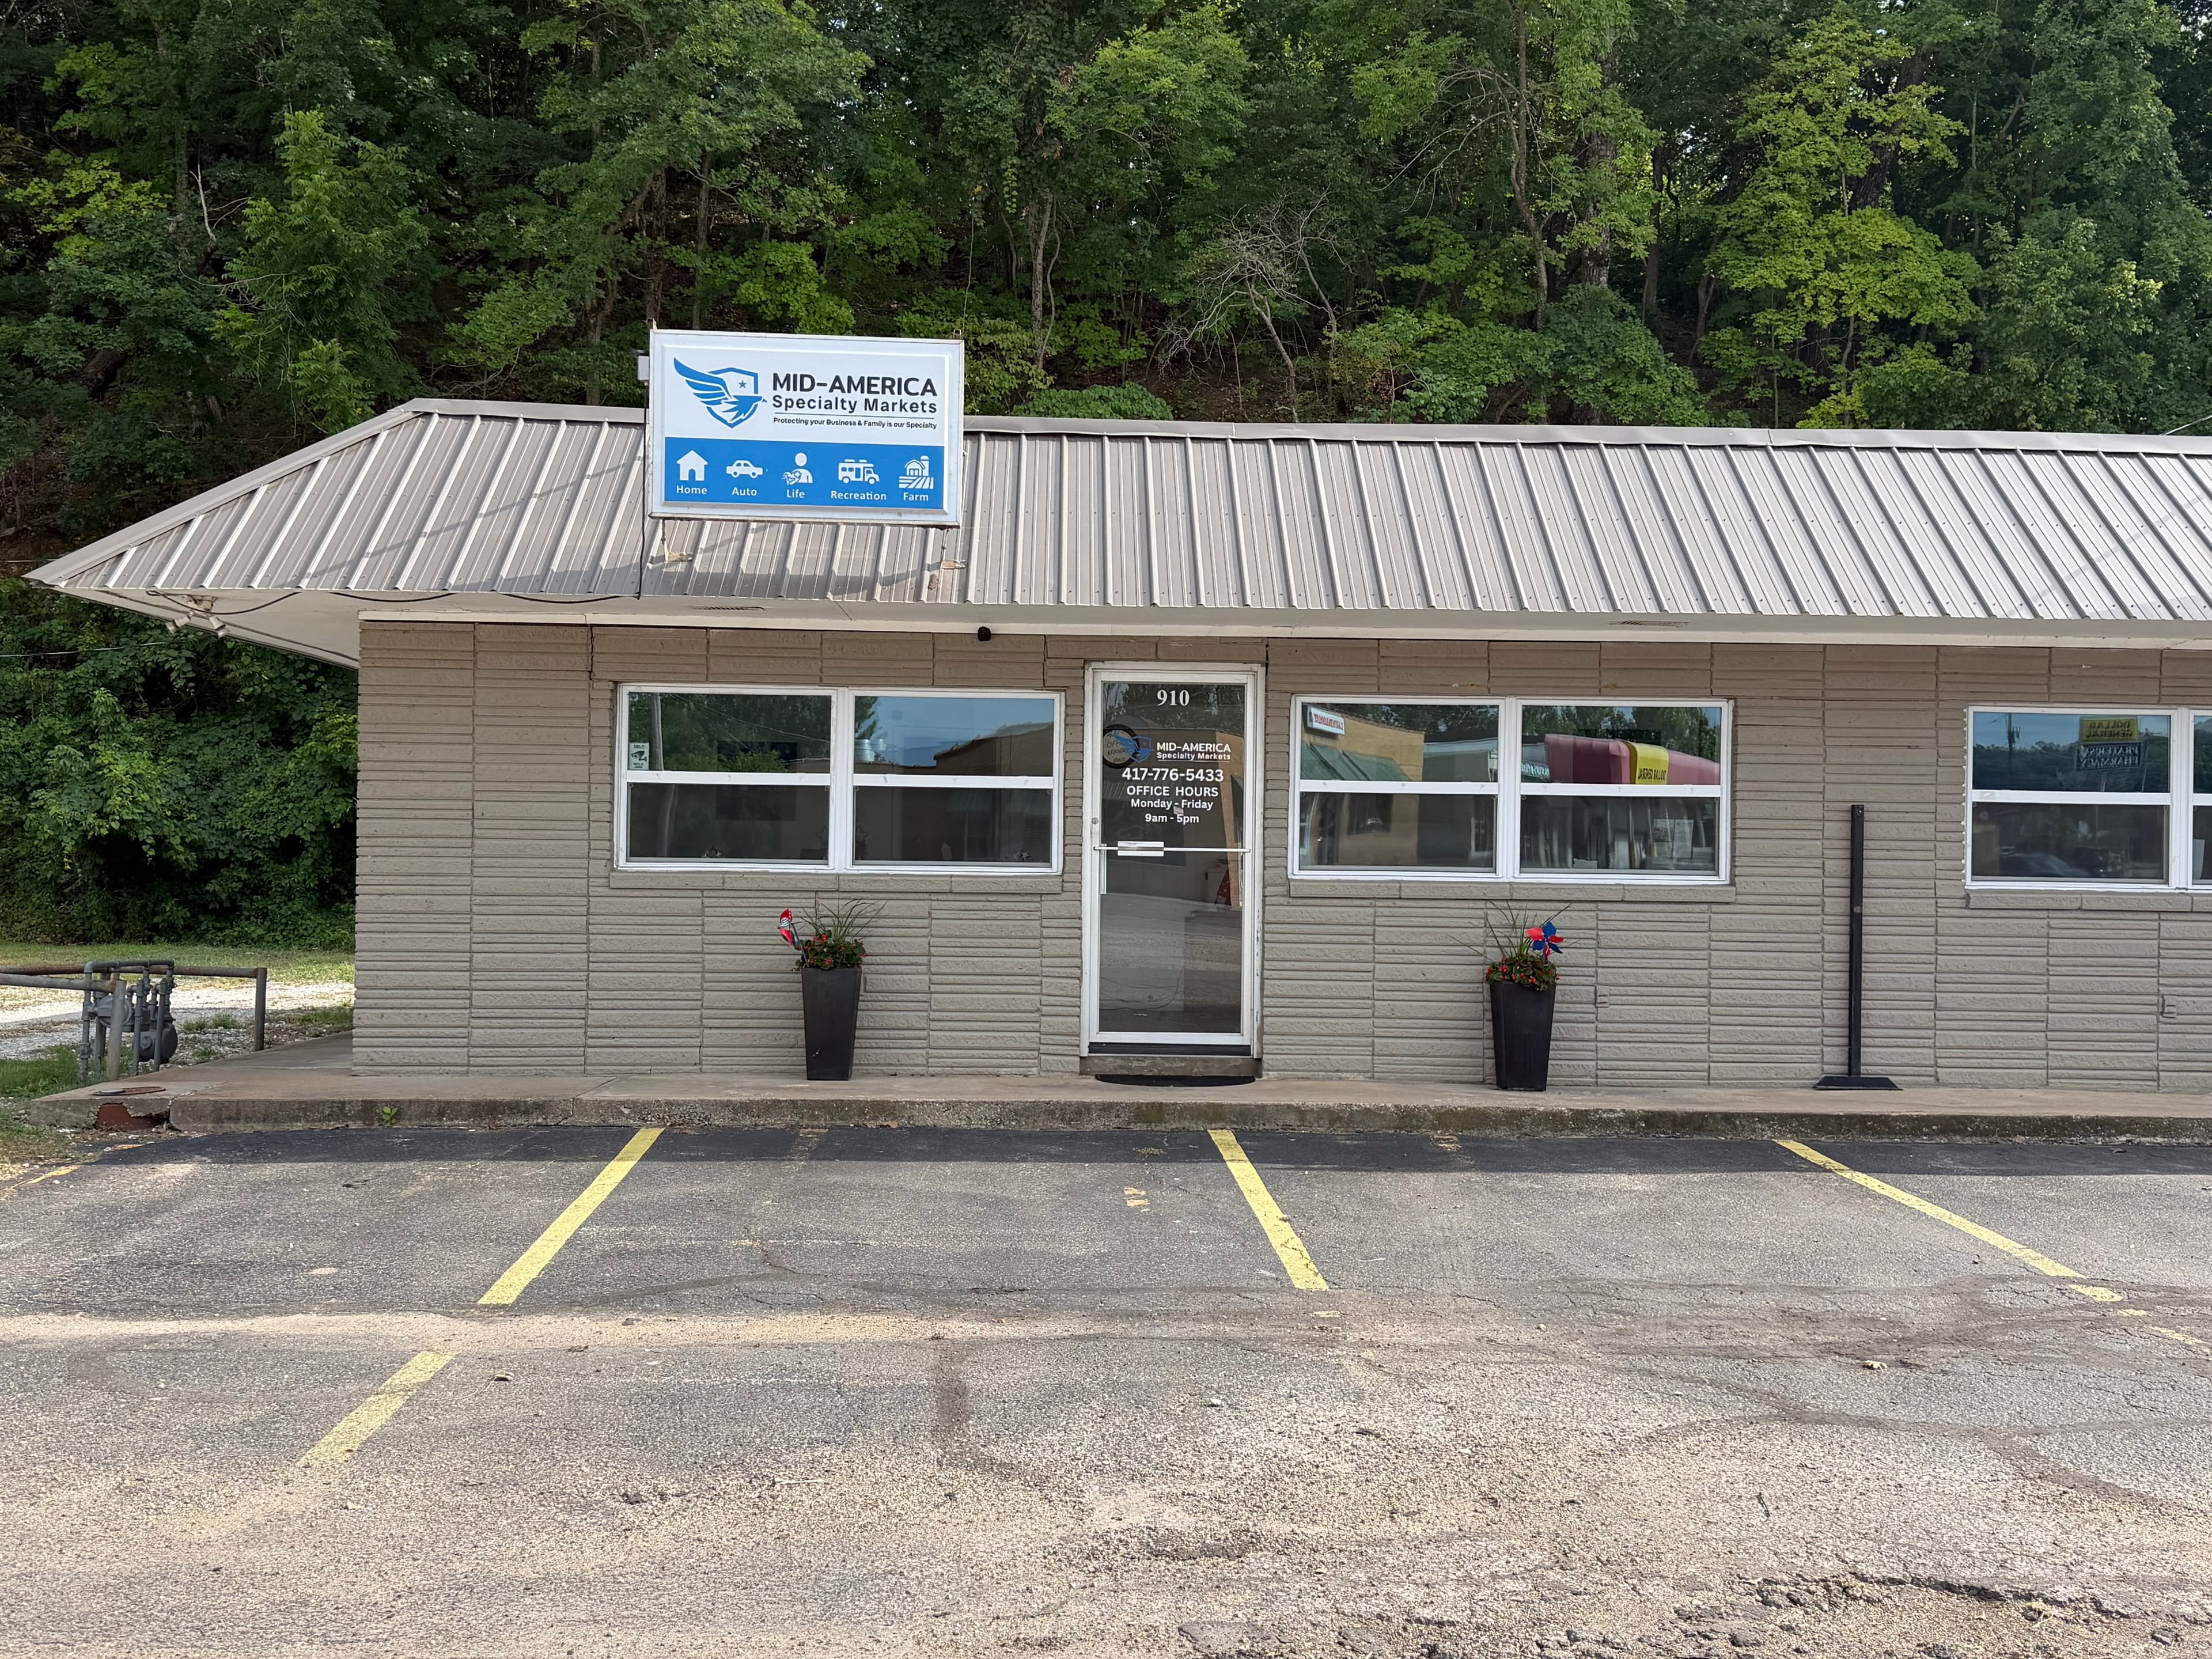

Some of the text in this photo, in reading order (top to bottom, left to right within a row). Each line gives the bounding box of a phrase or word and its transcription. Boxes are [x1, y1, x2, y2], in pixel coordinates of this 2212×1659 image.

[772, 373, 938, 397] MID-AMERICA
[772, 395, 937, 414] Specialty Markets
[774, 417, 809, 426] Protecting
[906, 422, 937, 430] Specialty
[676, 485, 708, 494] Home
[732, 487, 757, 497] Auto
[786, 488, 805, 498] Life
[831, 490, 887, 501] Recreation
[903, 492, 929, 501] Farm
[1157, 690, 1190, 706] 910
[1157, 742, 1231, 752] MID-AMERICA
[1157, 752, 1195, 761] Specialty
[1122, 767, 1224, 782] 417-776-5433
[1127, 786, 1219, 797] OFFICE HOURS
[1131, 798, 1172, 810] Monday
[1181, 800, 1214, 811] Friday
[1145, 813, 1168, 823] 9am
[1176, 814, 1199, 825] 5pm
